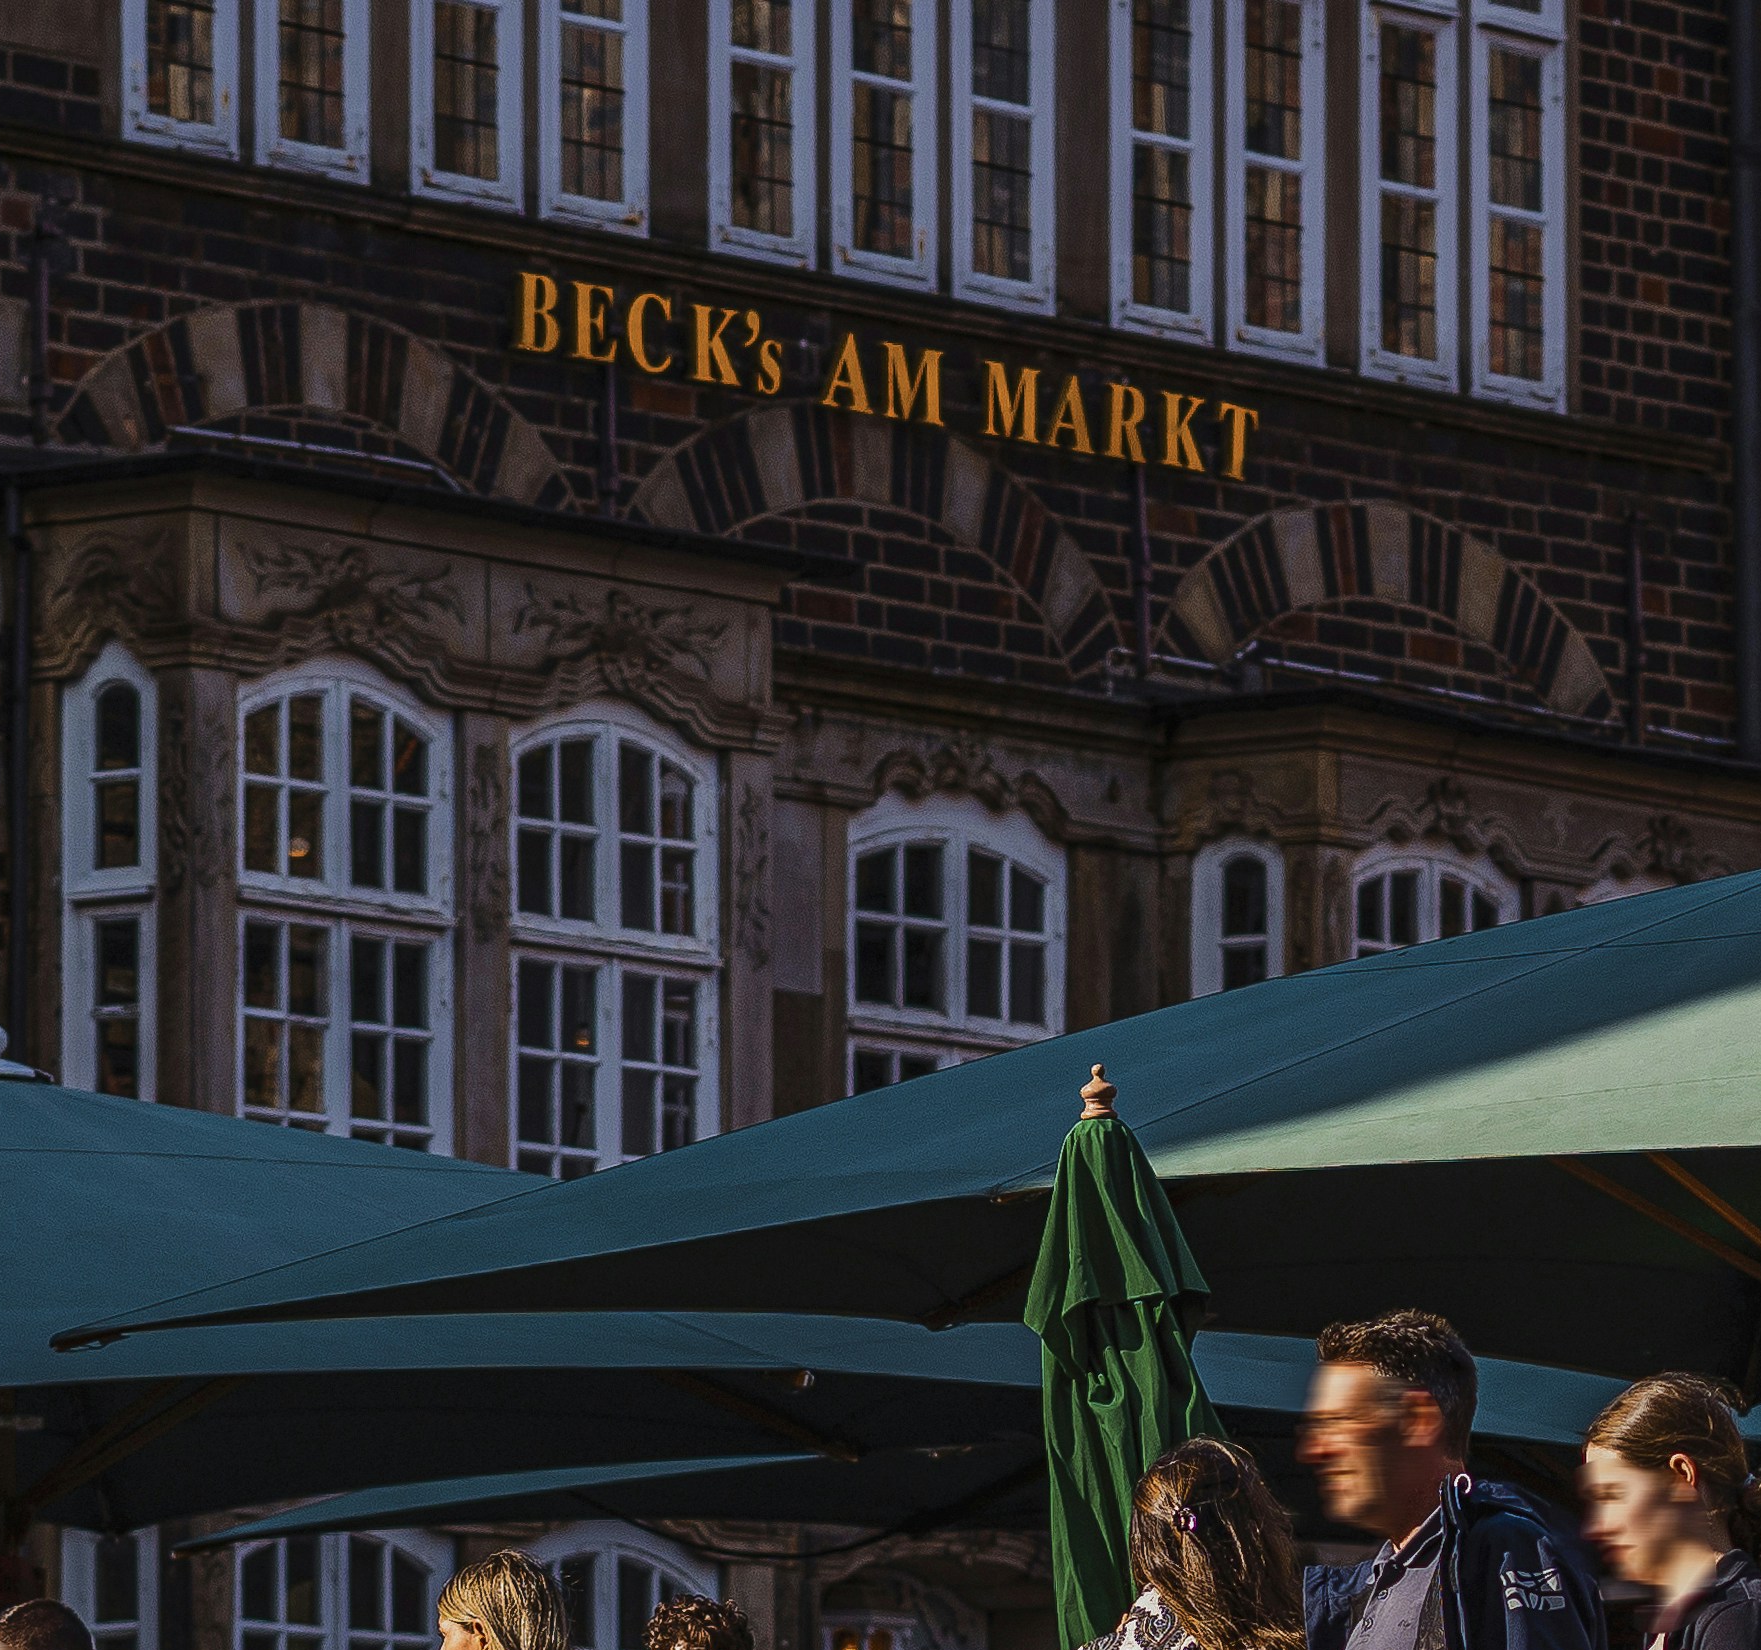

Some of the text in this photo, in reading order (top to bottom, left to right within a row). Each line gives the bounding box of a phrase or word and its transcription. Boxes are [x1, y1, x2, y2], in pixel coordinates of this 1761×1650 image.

[514, 270, 1260, 482] BECK's AM MARKT
